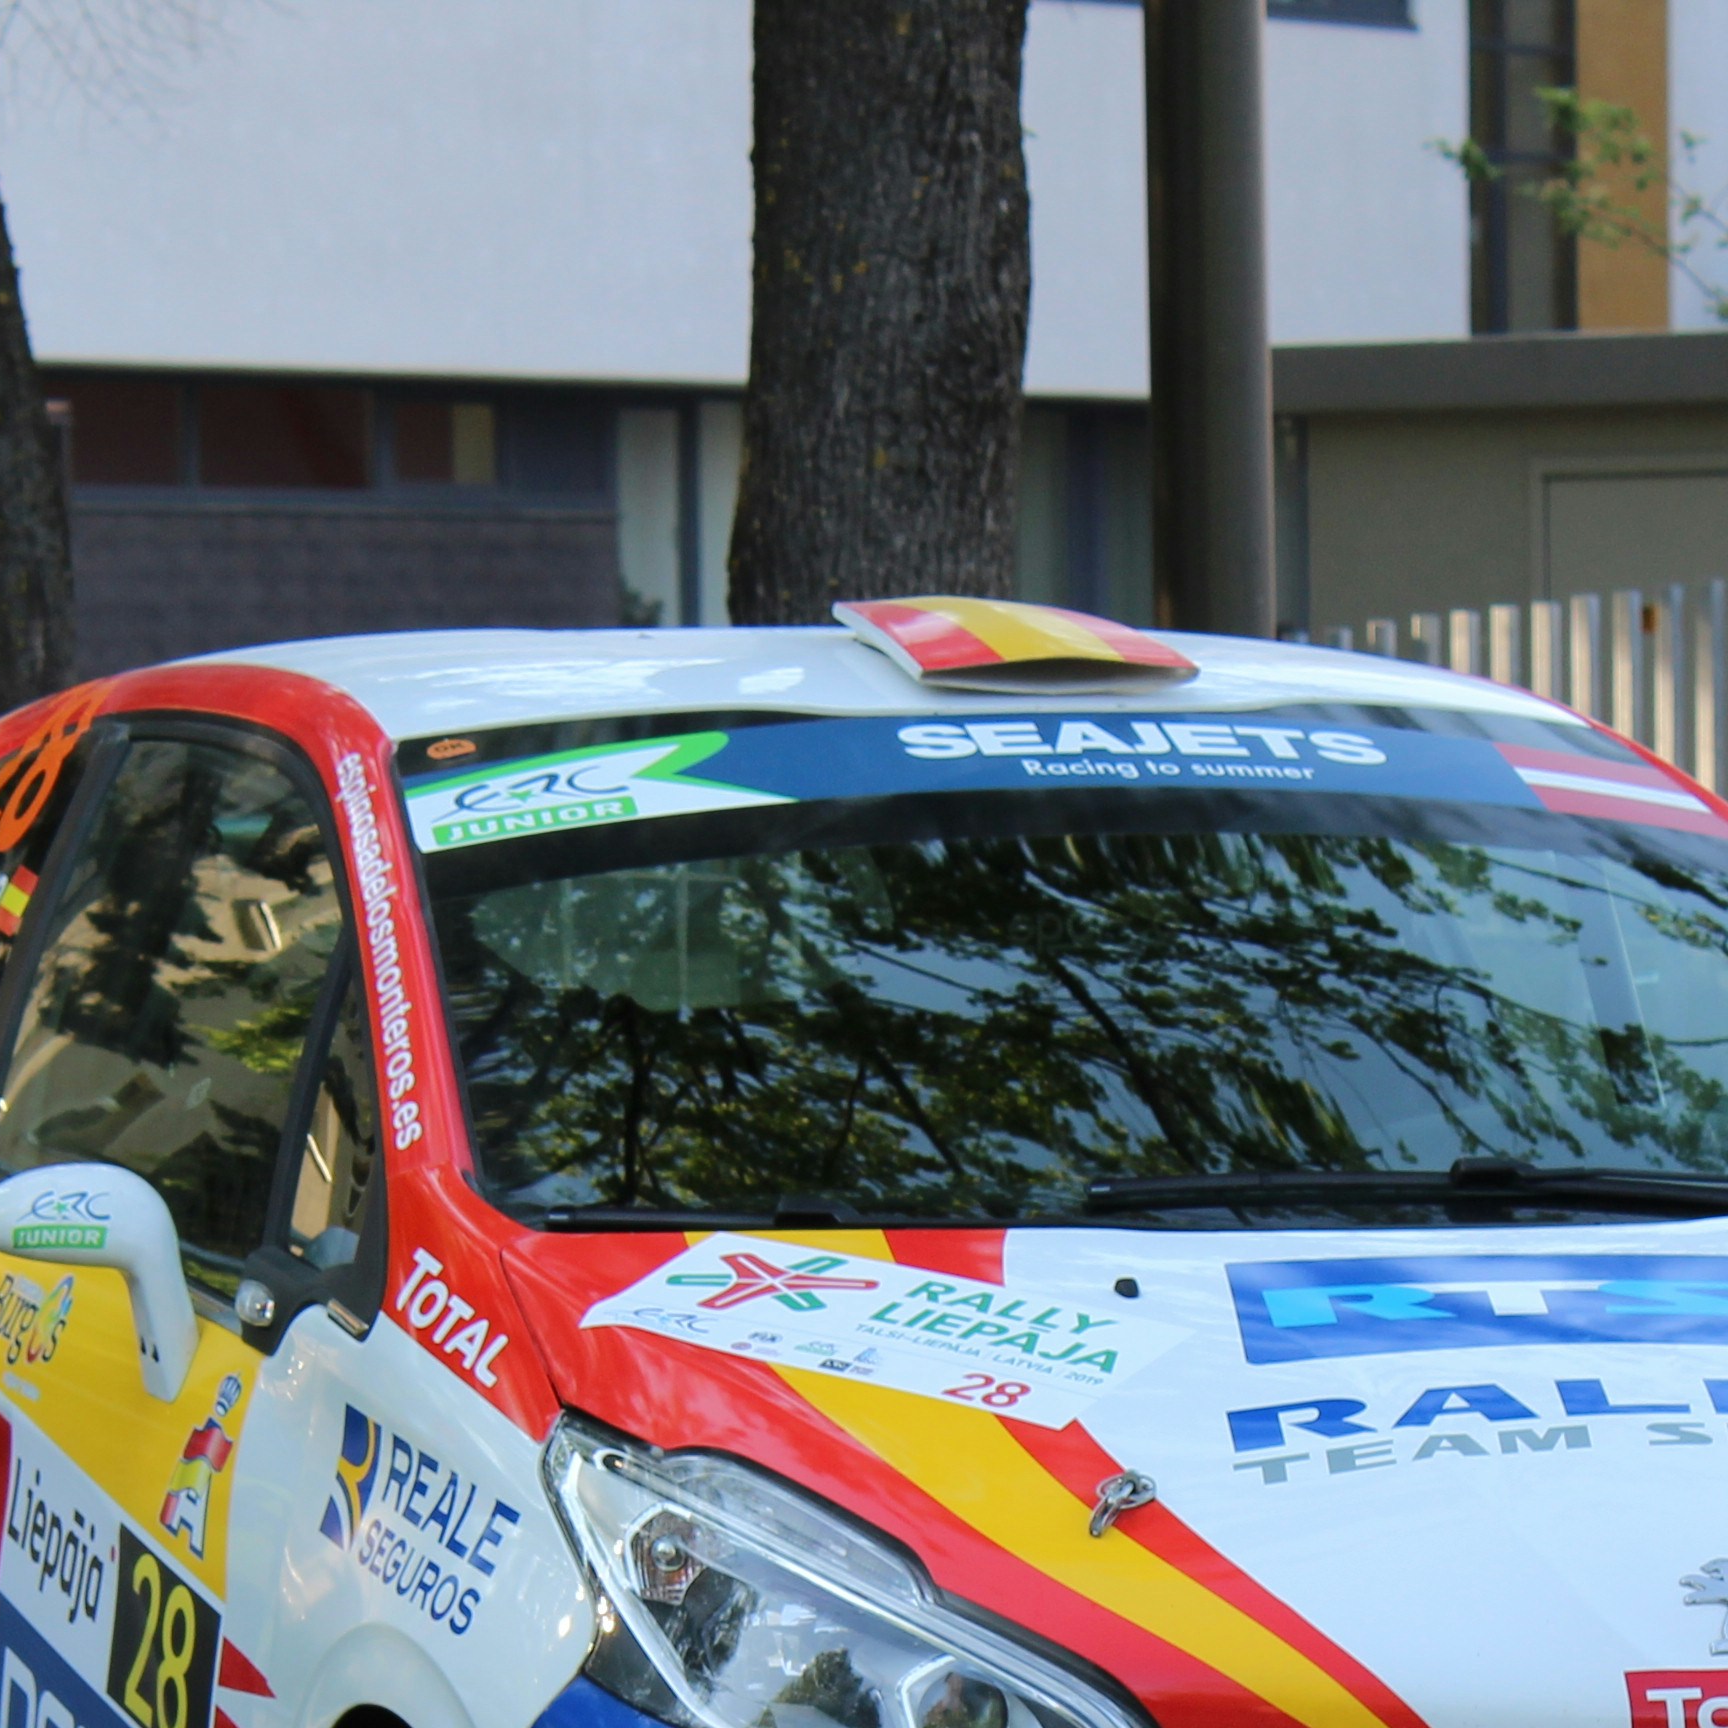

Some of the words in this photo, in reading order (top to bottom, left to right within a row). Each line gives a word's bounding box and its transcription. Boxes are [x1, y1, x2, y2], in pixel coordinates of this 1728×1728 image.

[898, 720, 1386, 765] SEAJETS
[1022, 758, 1140, 779] Racing
[1146, 759, 1180, 777] to
[1192, 762, 1315, 780] summer
[447, 801, 624, 842] JUNIOR
[337, 751, 423, 1153] espinosadelosmonteros.es
[19, 1228, 102, 1246] JUNIOR
[395, 1246, 511, 1389] TOTAL
[904, 1281, 1119, 1335] RALLY
[869, 1302, 1120, 1374] LIEPĀJA
[941, 1373, 1032, 1408] 28
[992, 1352, 1054, 1375] LATVIA
[1063, 1370, 1104, 1385] 2019
[1233, 1423, 1592, 1486] TEAM
[382, 1432, 521, 1578] REALE
[7, 1458, 104, 1623] Liepāja
[358, 1518, 481, 1636] SEGUROS
